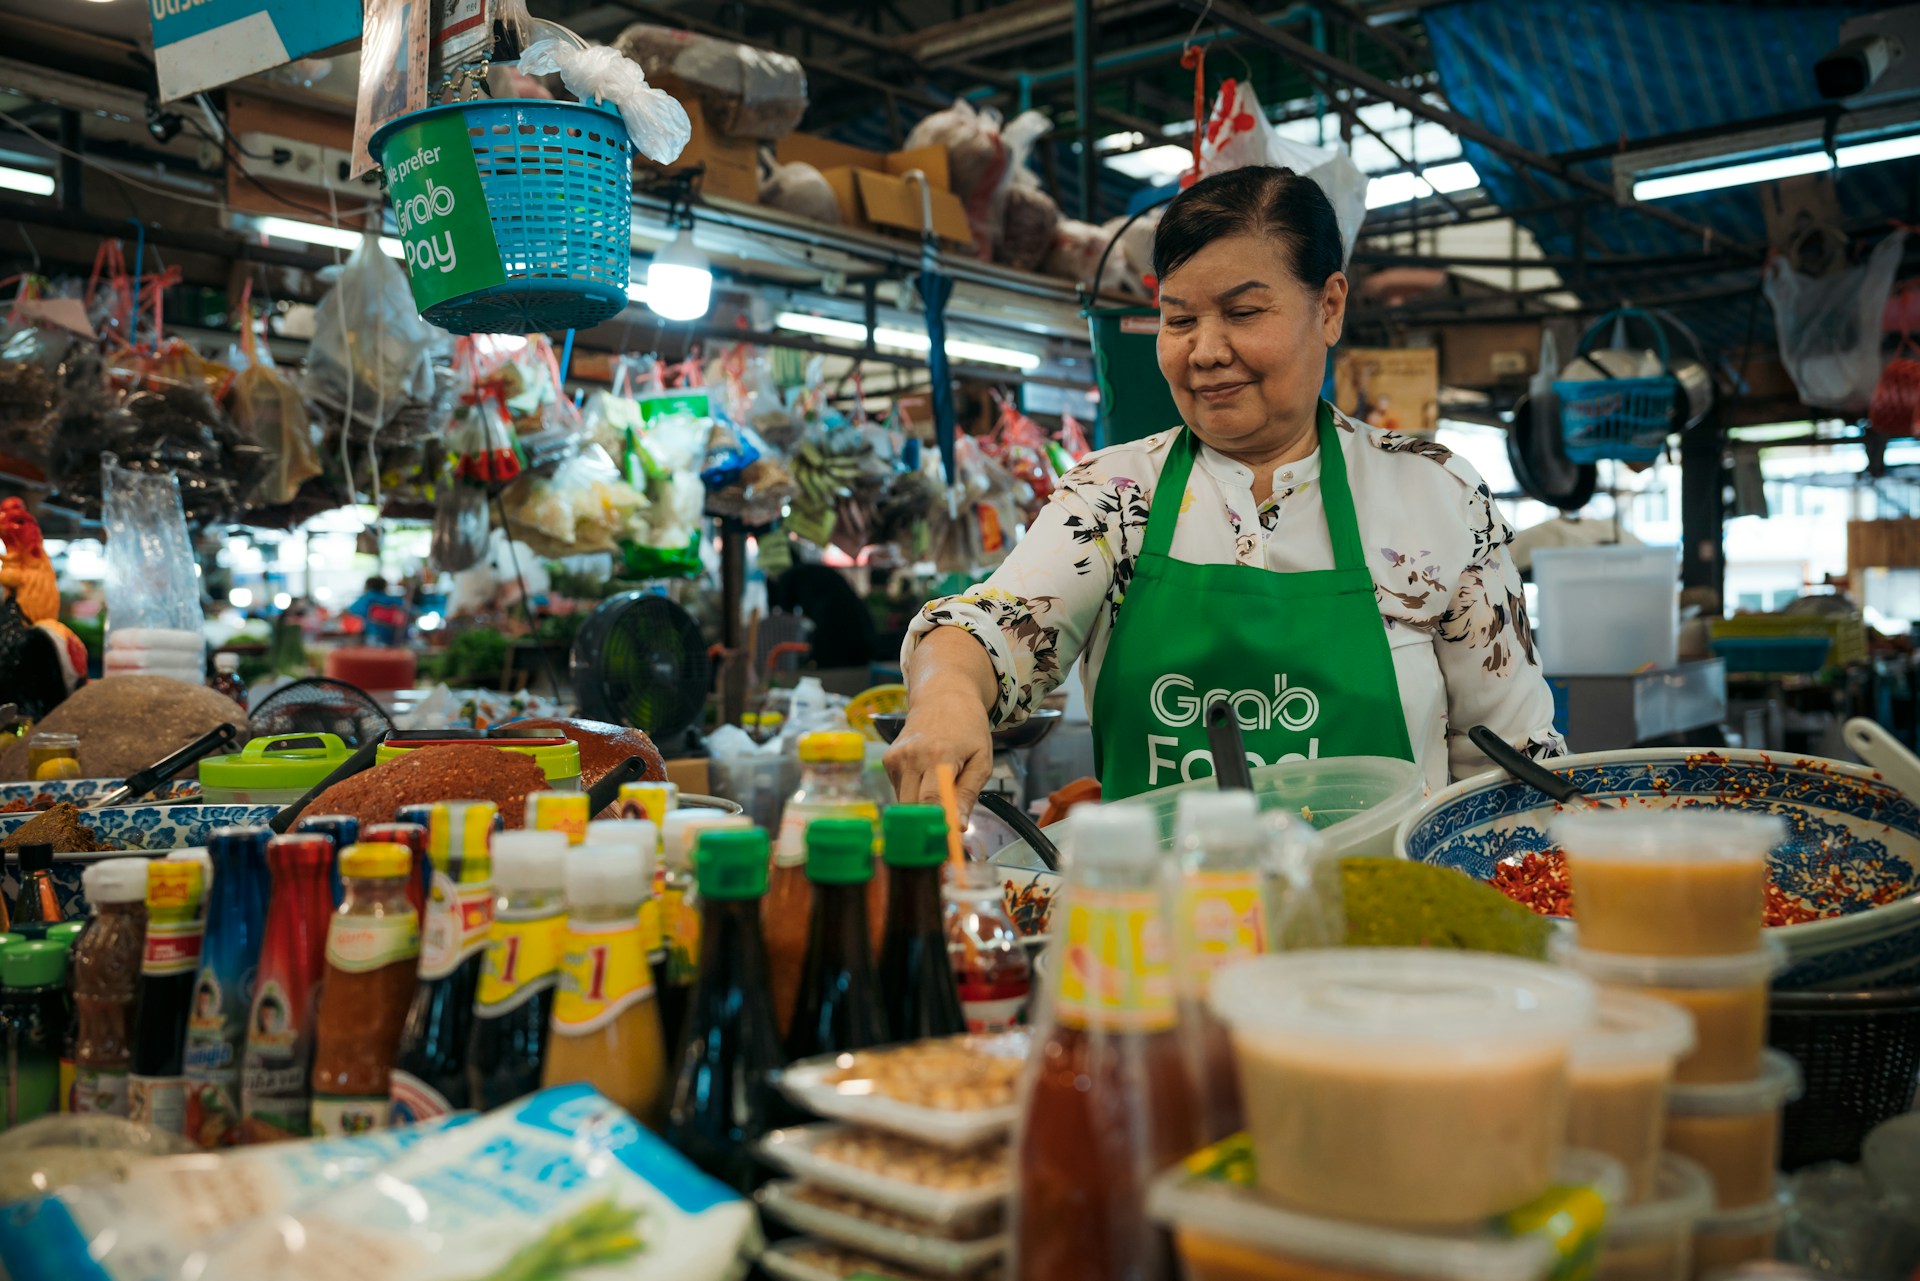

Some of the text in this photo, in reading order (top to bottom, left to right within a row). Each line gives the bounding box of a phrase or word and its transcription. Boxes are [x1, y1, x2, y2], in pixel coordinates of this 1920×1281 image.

[387, 146, 441, 187] We prefer
[395, 178, 456, 238] Grab
[404, 230, 457, 278] Pay
[1149, 673, 1320, 732] Grab
[1147, 734, 1320, 787] Fod
[585, 945, 608, 1002] 1
